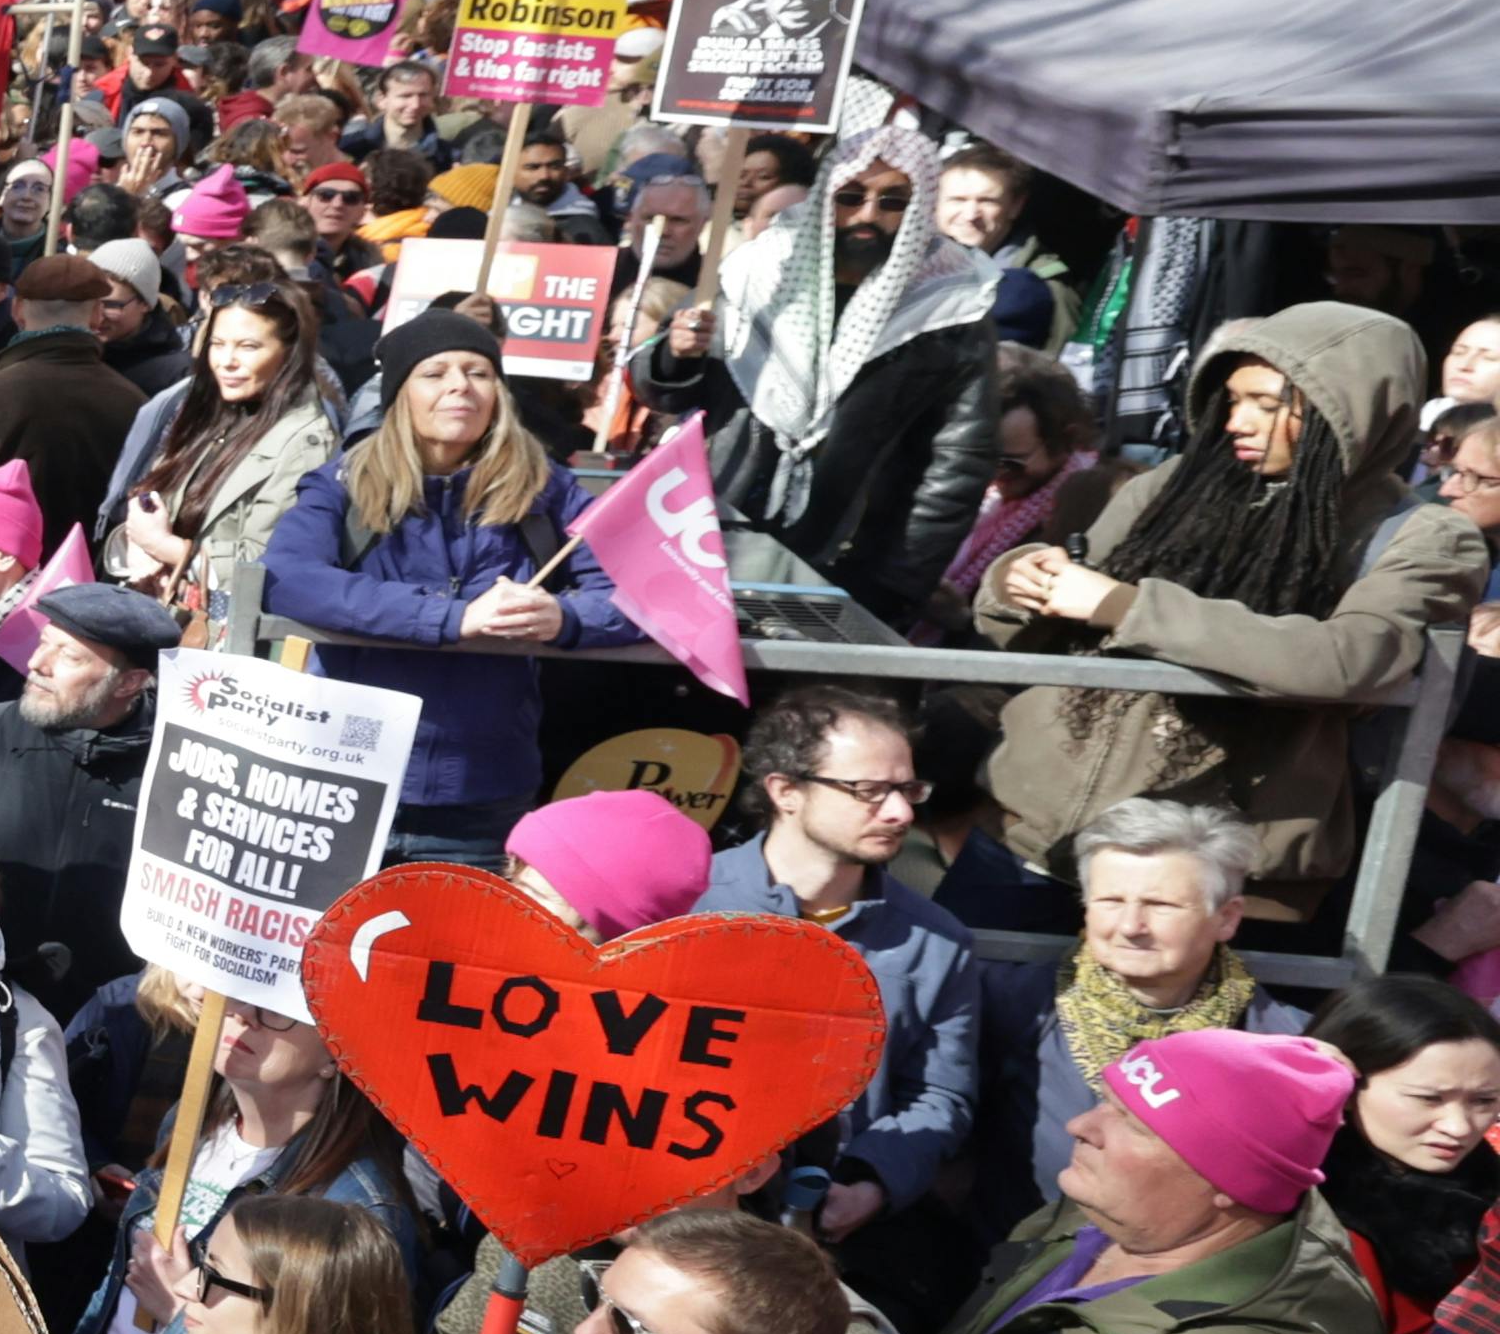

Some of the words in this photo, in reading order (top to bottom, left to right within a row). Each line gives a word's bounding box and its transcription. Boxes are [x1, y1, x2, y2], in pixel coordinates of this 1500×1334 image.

[458, 31, 509, 59] Stop
[512, 36, 597, 63] fascists
[691, 47, 795, 64] MOVEMENT
[797, 49, 824, 63] TO
[698, 36, 749, 52] BUILD
[763, 36, 822, 53] MASS
[453, 57, 473, 77] &
[474, 58, 512, 80] the
[513, 60, 547, 83] far
[547, 65, 603, 91] right
[724, 76, 773, 93] FIGHT
[774, 78, 811, 94] FOR
[544, 274, 598, 301] THE
[203, 691, 282, 727] Party
[219, 675, 333, 727] Socialist
[216, 715, 367, 767] socialistparty.org.uk
[167, 737, 238, 793] JOBS,
[245, 764, 361, 826] HOMES
[176, 793, 199, 822] &
[201, 797, 334, 864] SERVICES
[183, 832, 233, 875] FOR
[233, 845, 304, 900] ALL!
[140, 860, 222, 920] SMASH
[224, 898, 317, 949] RACIS
[146, 906, 179, 932] BUILD
[186, 922, 211, 947] NEW
[207, 932, 270, 966] WORKERS'
[164, 932, 195, 956] FIGHT
[191, 941, 214, 964] FOR
[211, 950, 279, 989] SOCIALISM
[415, 959, 747, 1070] LOVE
[424, 1052, 738, 1162] WINS
[1116, 1049, 1182, 1111] UCU
